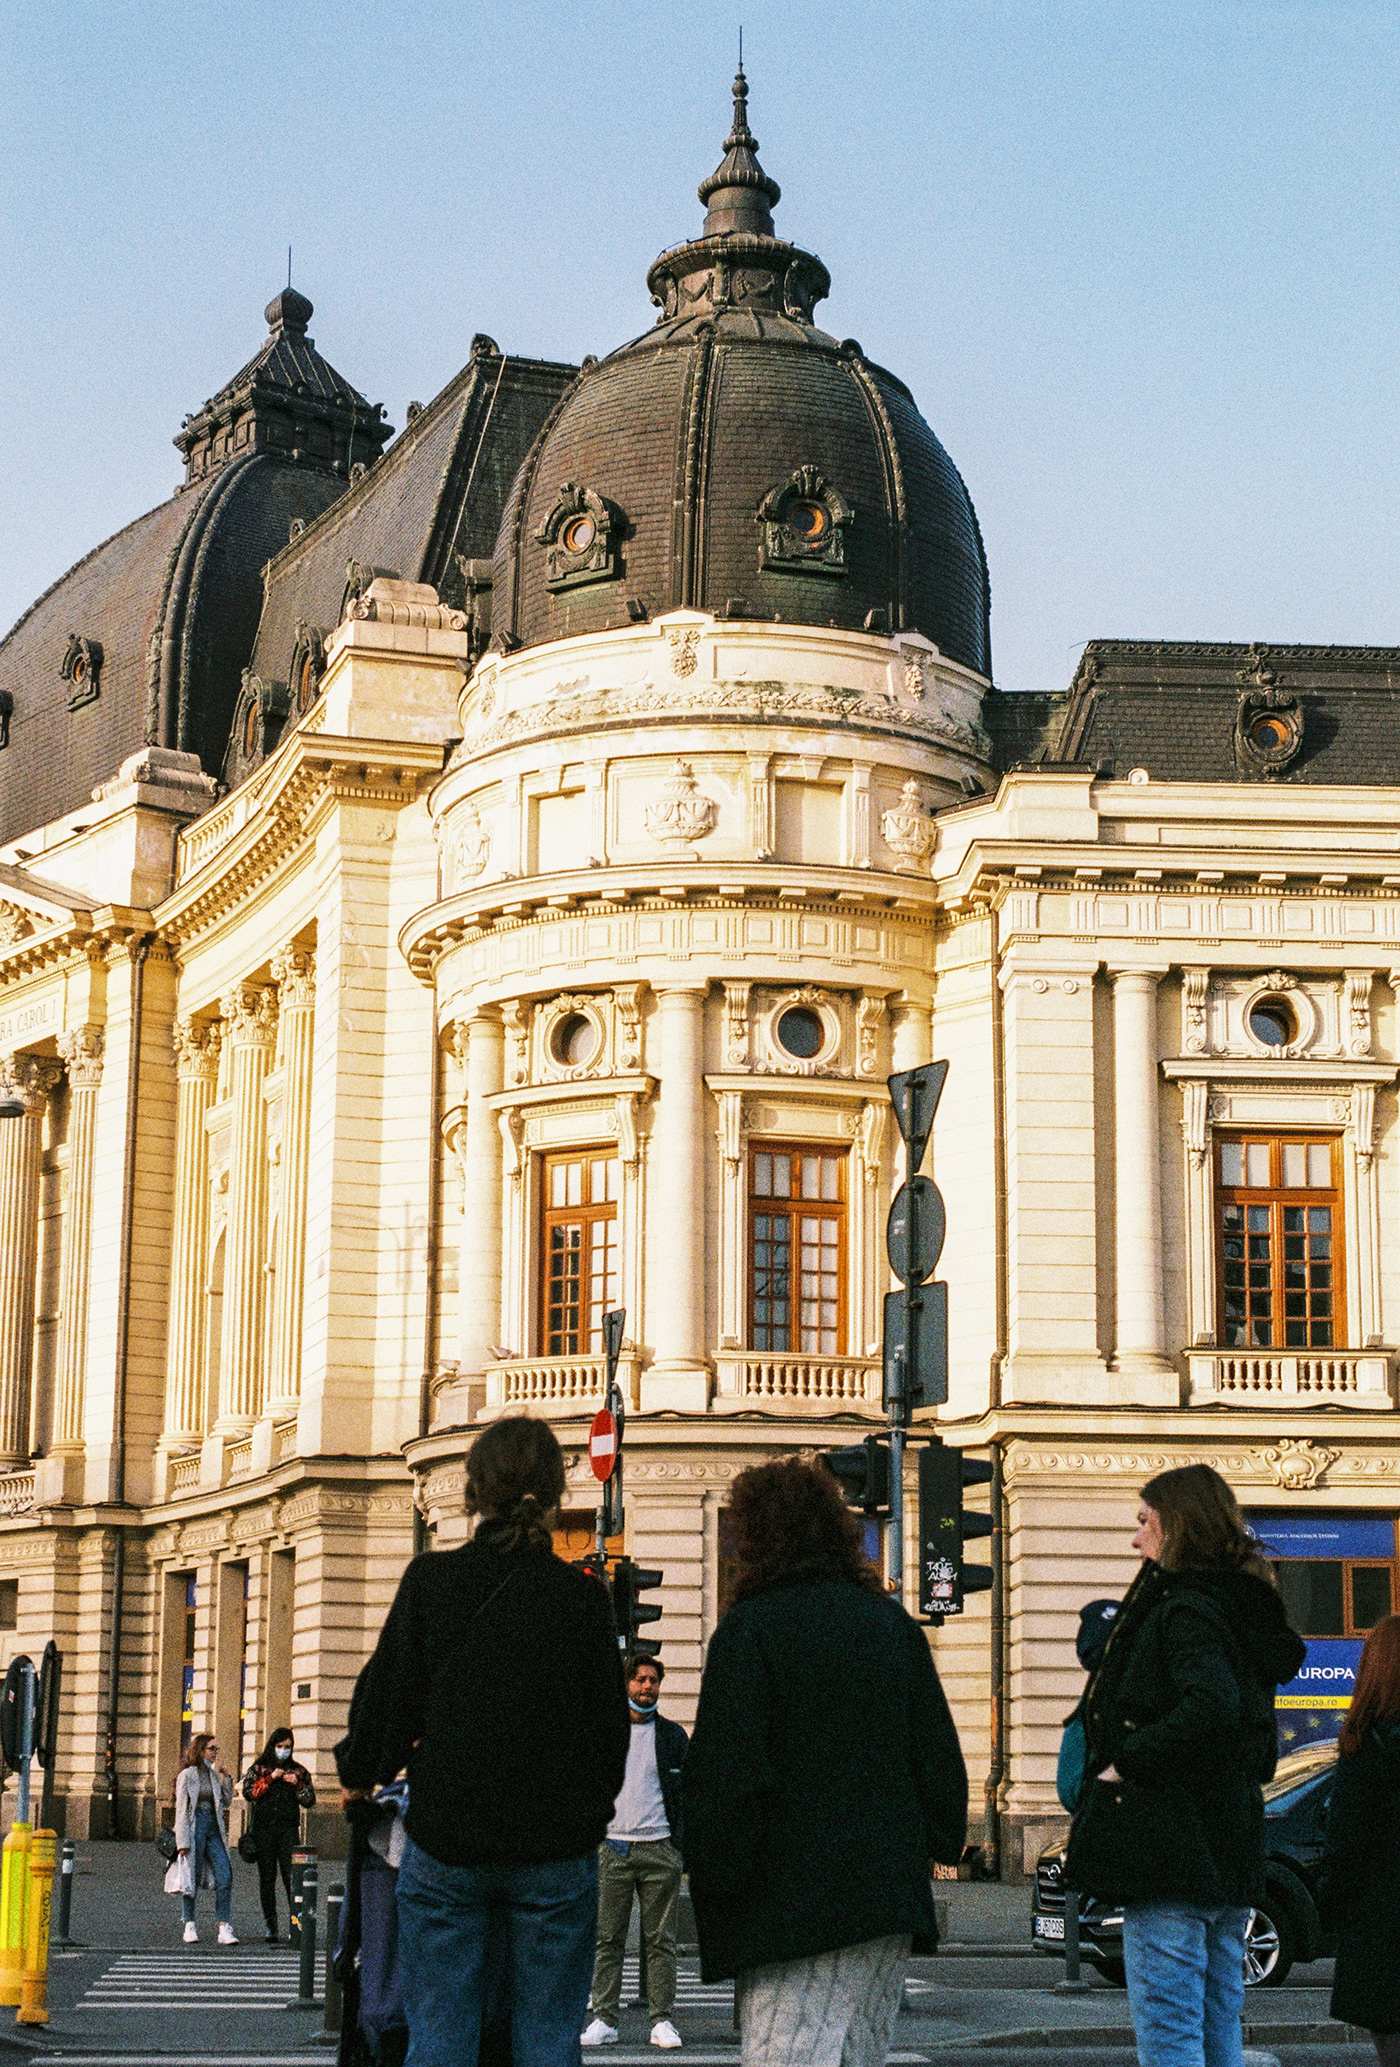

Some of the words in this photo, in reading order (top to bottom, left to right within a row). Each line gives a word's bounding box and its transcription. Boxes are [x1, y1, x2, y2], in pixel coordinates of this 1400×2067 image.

[17, 1003, 48, 1033] CAROL
[1295, 1667, 1356, 1680] UROPA
[1275, 1696, 1338, 1707] nfoeuropa.ro
